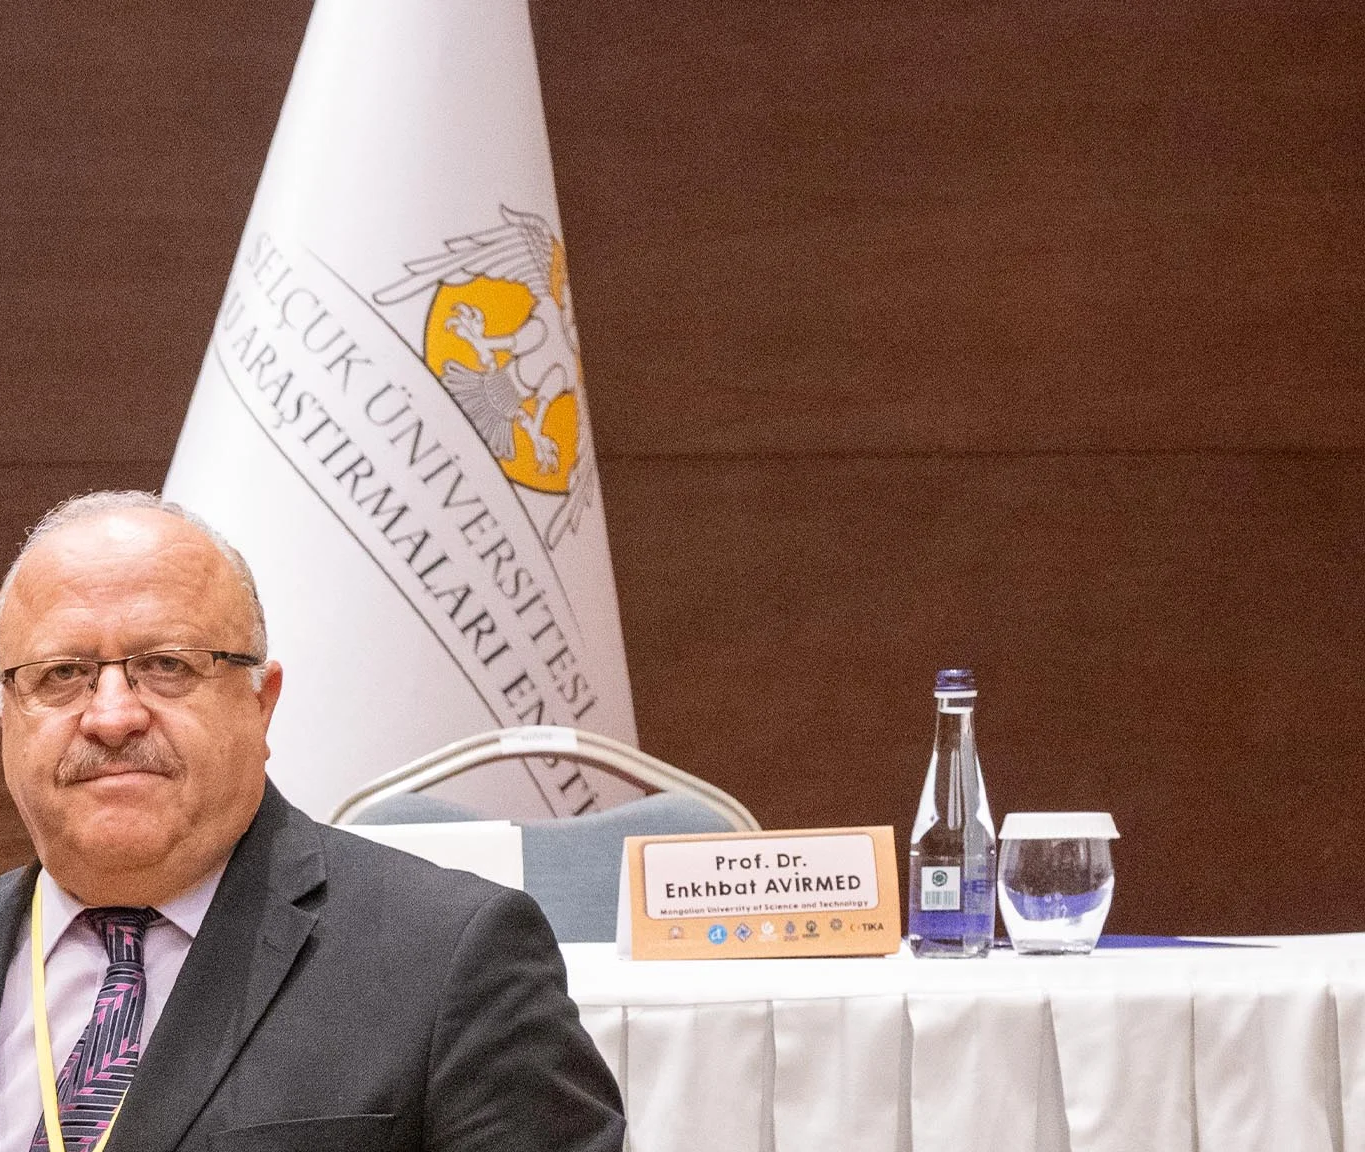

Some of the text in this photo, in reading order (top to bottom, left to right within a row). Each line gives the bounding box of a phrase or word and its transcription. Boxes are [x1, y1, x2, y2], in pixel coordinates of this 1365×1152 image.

[246, 231, 599, 720] SELÇUK ÜNİVERSİTESİ
[231, 325, 510, 666] ARAŞTIRMALARI
[715, 853, 808, 871] Prof. Dr.
[665, 871, 861, 899] Enkhbat AVİRMED
[660, 898, 869, 916] Mongolian University of Science and Technology
